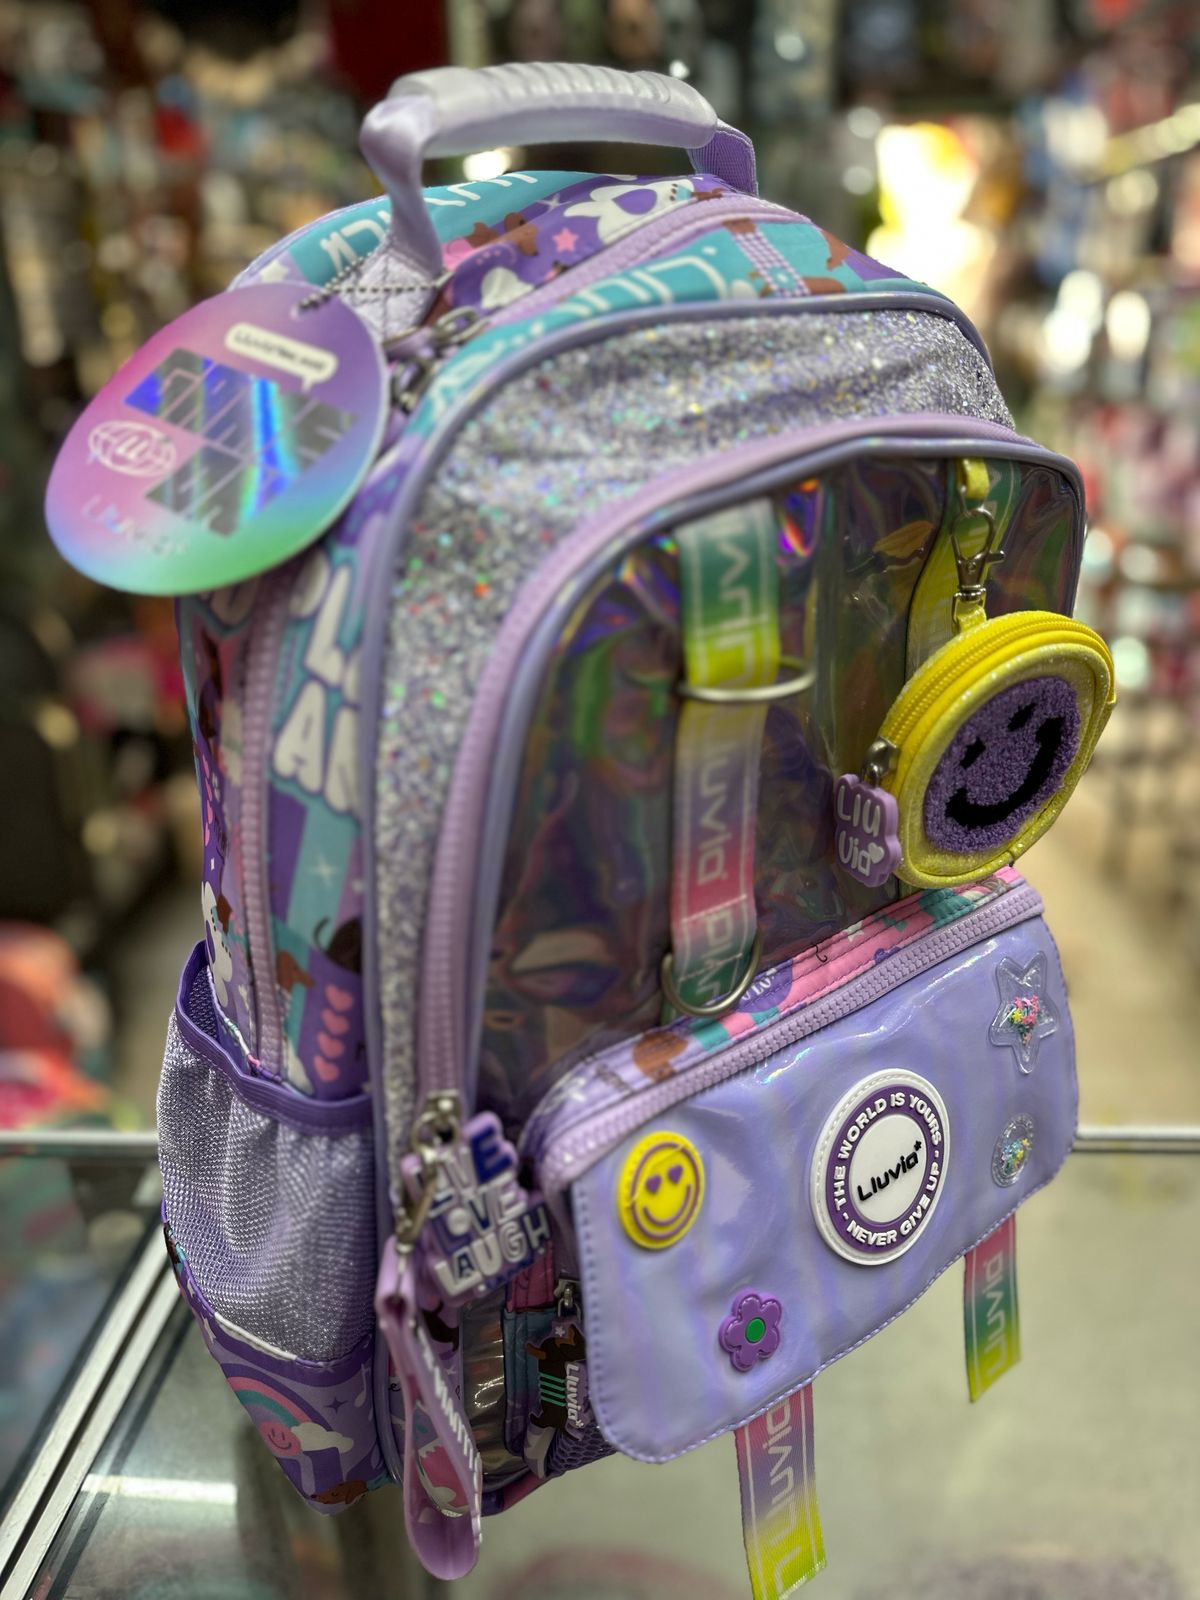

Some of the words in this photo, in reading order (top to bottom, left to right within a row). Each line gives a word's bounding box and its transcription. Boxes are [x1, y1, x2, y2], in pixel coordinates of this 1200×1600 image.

[890, 1091, 905, 1107] IS
[909, 1094, 942, 1146] YOURS
[837, 1097, 887, 1160] WORLD
[833, 1165, 847, 1211] THE
[846, 1220, 898, 1247] NEVER
[900, 1193, 931, 1236] GIVE
[926, 1161, 940, 1193] UP
[433, 1203, 550, 1297] LAUGH
